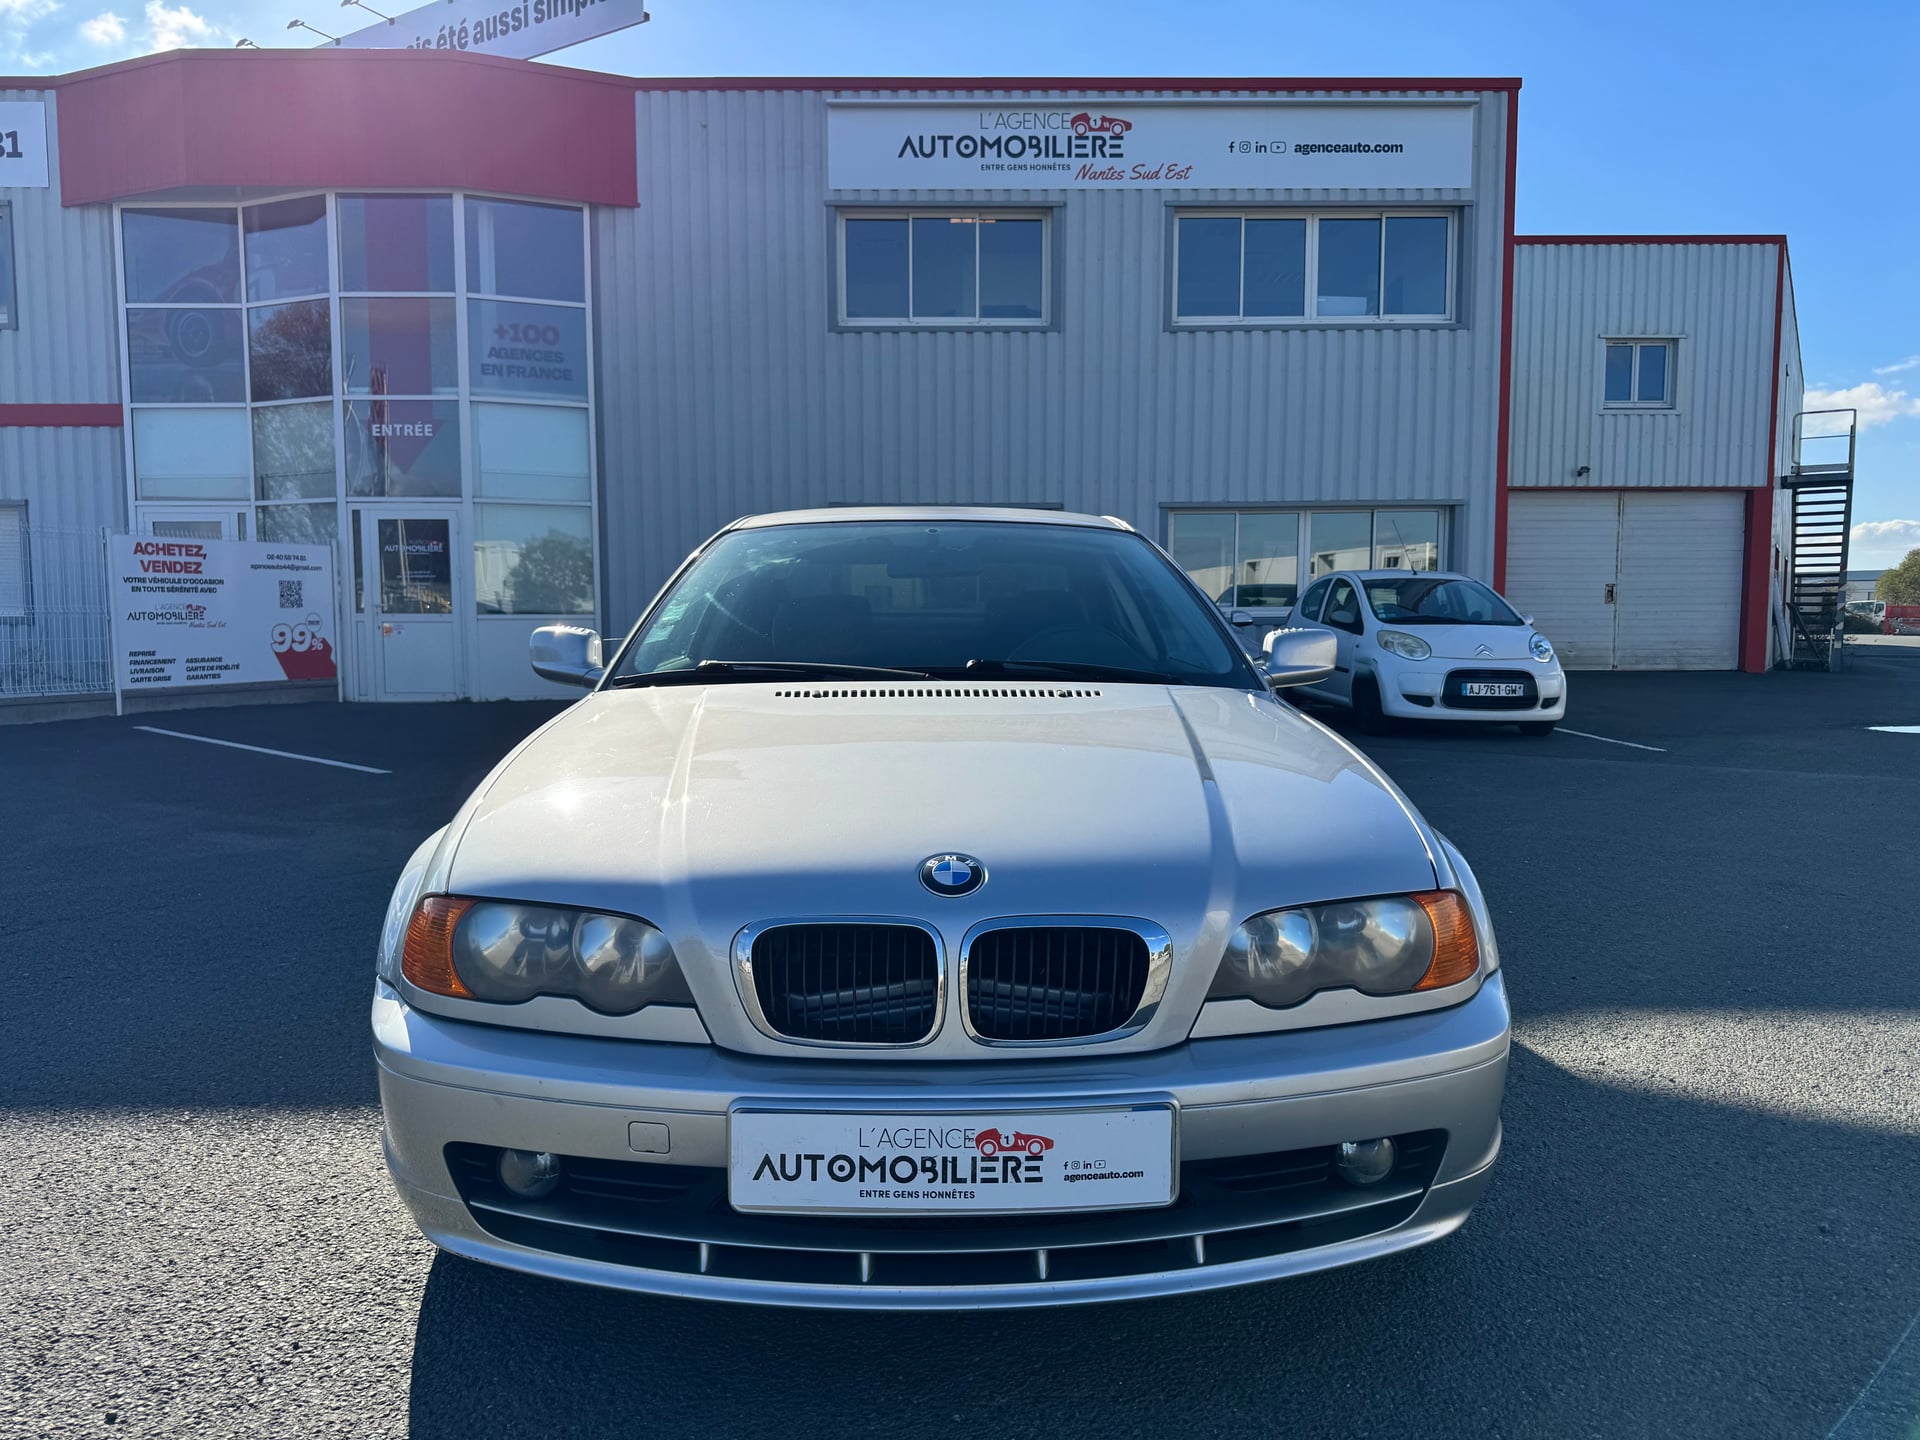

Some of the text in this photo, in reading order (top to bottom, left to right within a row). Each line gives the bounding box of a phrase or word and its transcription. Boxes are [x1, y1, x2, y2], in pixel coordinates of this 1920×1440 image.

[437, 18, 469, 50] été
[473, 0, 529, 45] aussi
[979, 112, 1071, 130] L'AGENCE
[0, 130, 23, 158] 1
[1294, 142, 1404, 156] agenceauto.com
[980, 162, 1071, 172] ENTRE GENS HONNÊTES
[1075, 161, 1194, 182] Nantes Sud Est
[493, 323, 560, 346] +100
[487, 346, 565, 364] AGENCES
[480, 363, 573, 382] EN FRANCE
[371, 421, 434, 437] ENTRÉE
[133, 541, 207, 560] ACHETEZ,
[139, 559, 203, 575] VENDEZ
[122, 576, 225, 586] VOTRE VÉHICULE D'OCCASION
[131, 585, 142, 593] EN
[166, 584, 199, 594] SÉRÉNITÉ
[200, 586, 218, 594] AVEC
[128, 650, 157, 658] REPRISE
[185, 656, 223, 664] ASSURANCE
[129, 658, 177, 666] FINANCEMENT
[186, 662, 241, 673] CARTE DE FIDÉLITÉ
[129, 667, 166, 675] LIVRAISON
[186, 673, 222, 681] GARANTIES
[130, 675, 153, 684] CARTE
[926, 855, 977, 868] BMW
[858, 1127, 977, 1149] L'AGENCE
[1063, 1171, 1144, 1183] agenceauto.com
[859, 1188, 976, 1200] ENTRE GENS HONNÊTES
